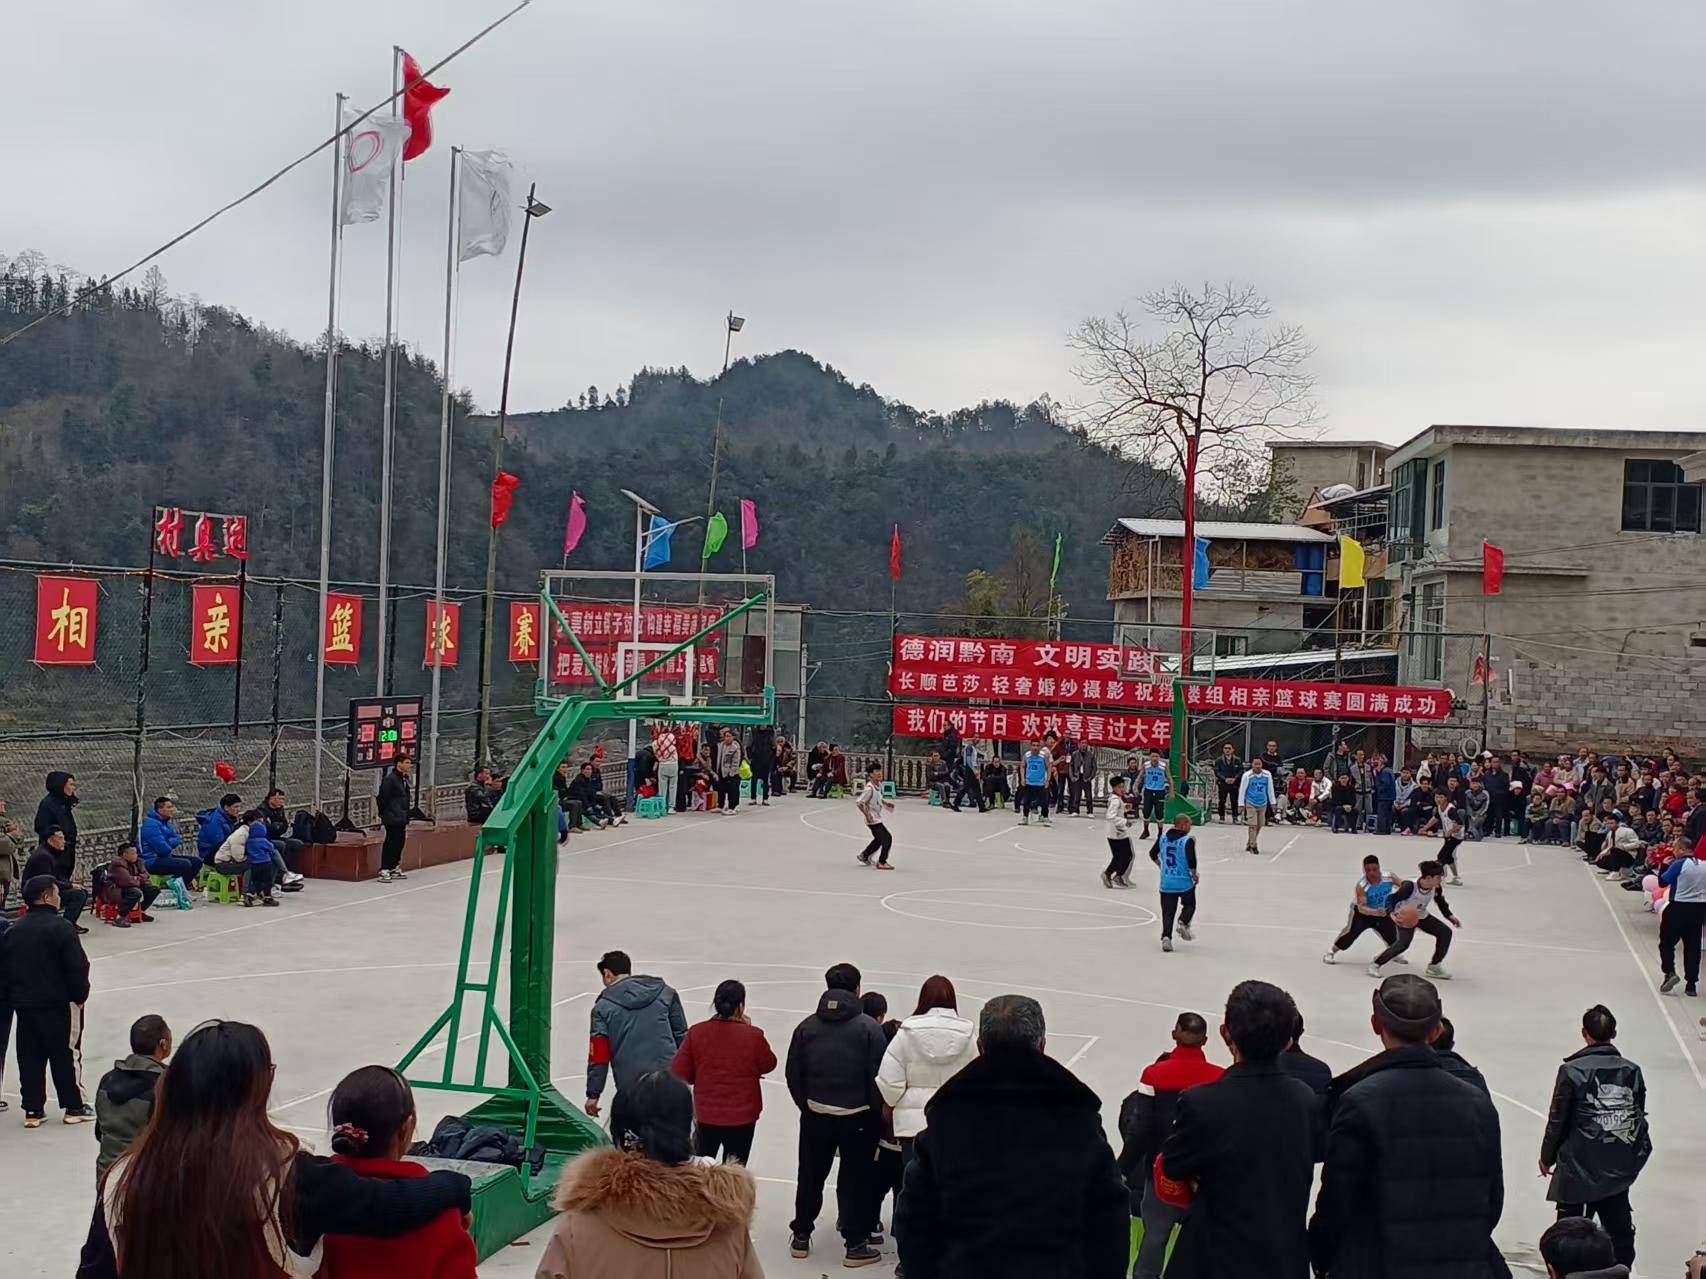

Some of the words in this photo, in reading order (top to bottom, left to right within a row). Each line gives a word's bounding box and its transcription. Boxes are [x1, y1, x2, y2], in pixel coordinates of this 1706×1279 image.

[900, 638, 1016, 666] 德润黔南
[1034, 644, 1152, 673] 文明实践
[907, 708, 1007, 736] 我们的节日
[1022, 713, 1171, 745] 欢欢喜喜过大年
[1165, 845, 1178, 868] 5
